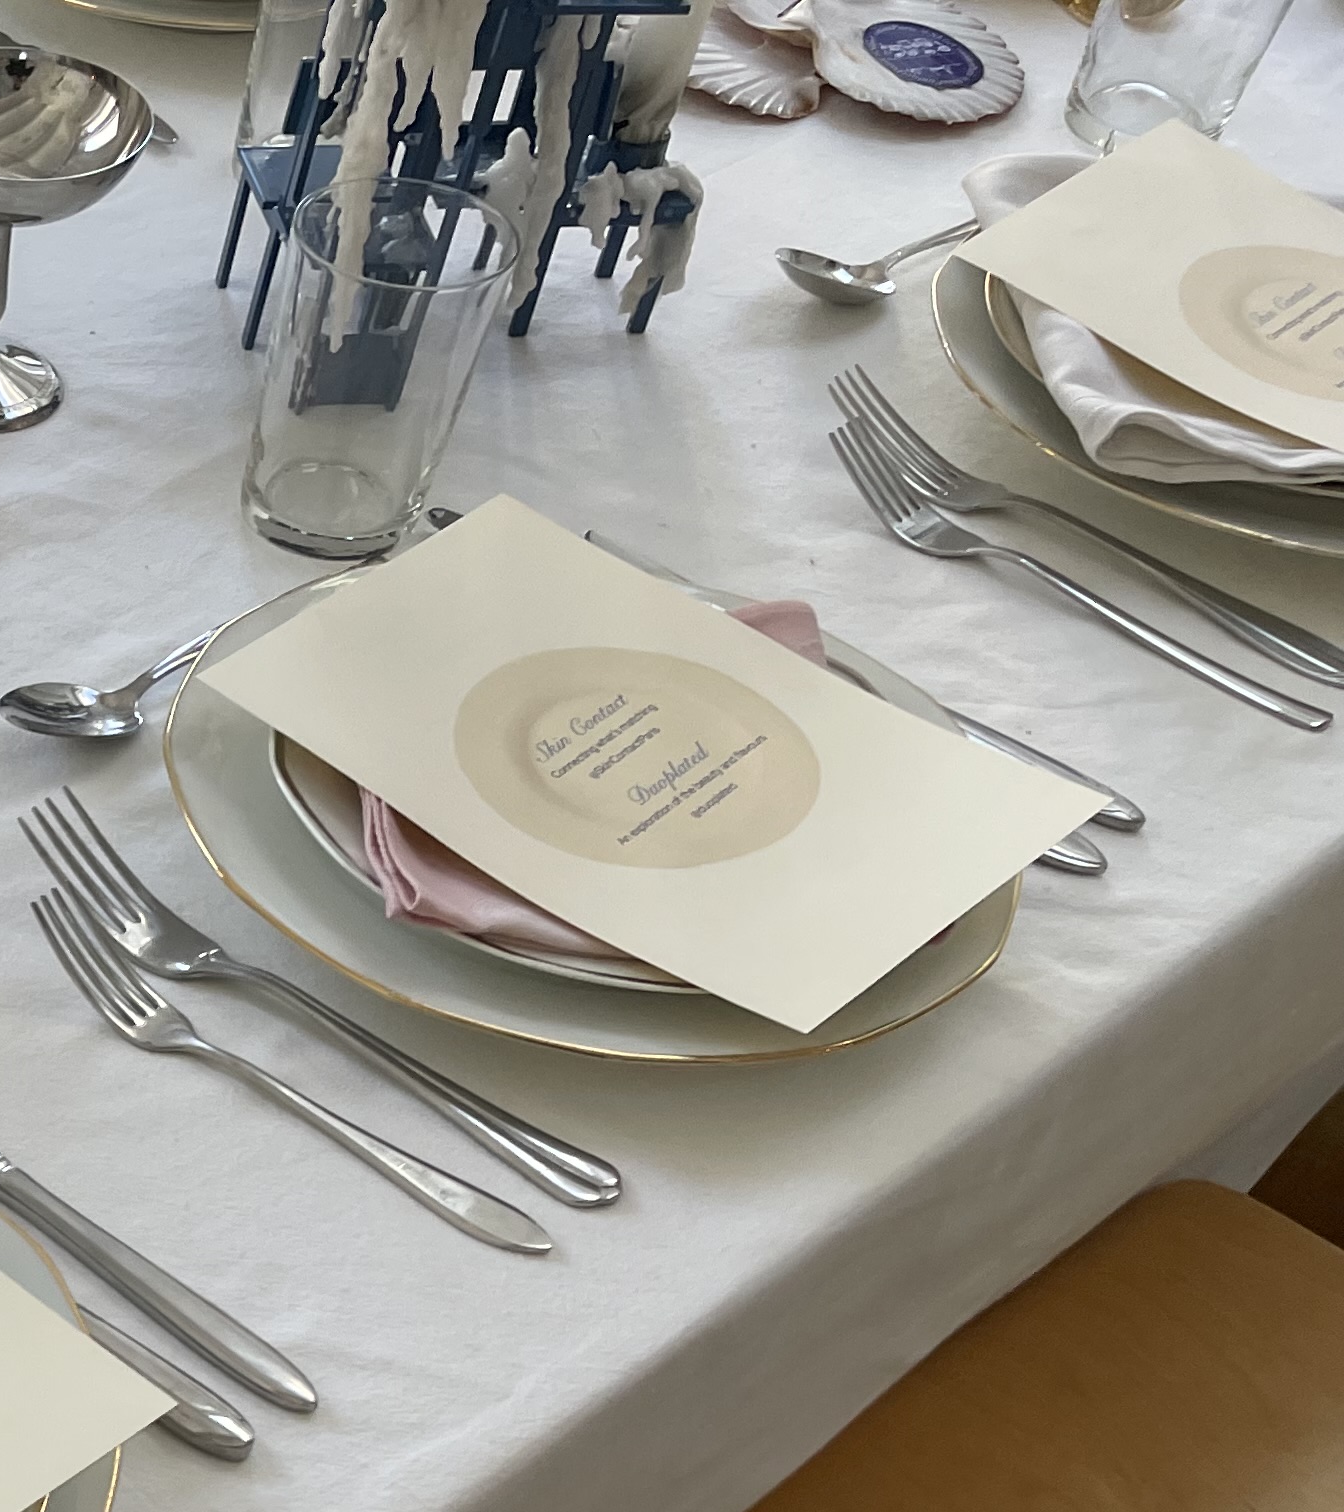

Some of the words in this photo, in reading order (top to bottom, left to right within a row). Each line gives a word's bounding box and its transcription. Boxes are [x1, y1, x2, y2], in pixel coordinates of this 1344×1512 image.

[536, 736, 571, 763] Skin
[570, 694, 628, 735] Contact
[627, 740, 709, 806] Duoplated
